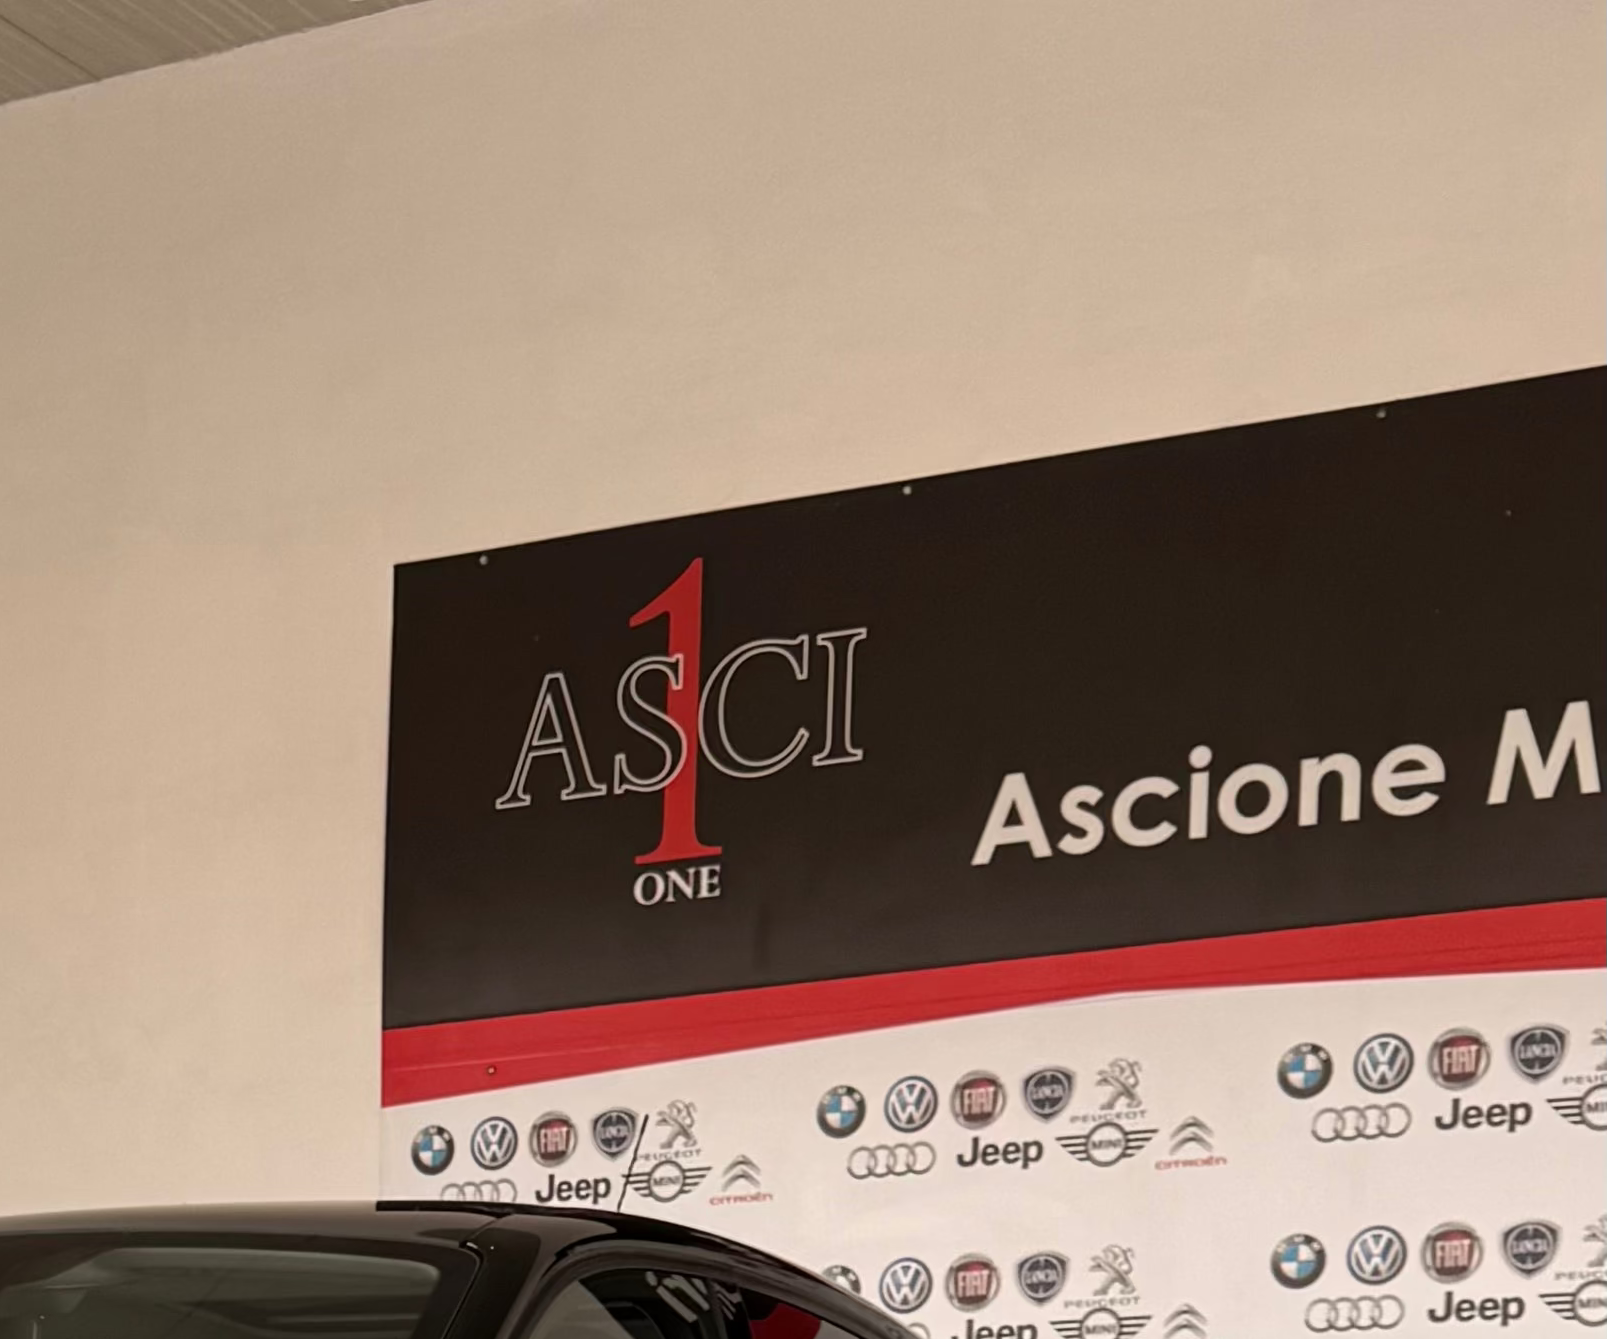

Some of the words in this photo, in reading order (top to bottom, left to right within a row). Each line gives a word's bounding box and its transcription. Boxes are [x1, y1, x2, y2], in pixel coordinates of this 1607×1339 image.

[972, 743, 1447, 865] Ascione
[1487, 699, 1607, 803] M
[633, 864, 722, 907] ONE
[1443, 1044, 1478, 1074] FIAT
[962, 1085, 996, 1113] FIAT
[1434, 1097, 1533, 1133] Jeep
[539, 1127, 570, 1153] FIAT
[956, 1136, 1044, 1169] Jeep
[1091, 1138, 1122, 1151] MINI
[535, 1174, 611, 1205] Jeep
[653, 1175, 681, 1187] MINI
[1436, 1239, 1471, 1268] FIAT
[956, 1269, 991, 1297] FIAT
[1426, 1290, 1526, 1327] Jeep
[1085, 1323, 1117, 1336] MINI
